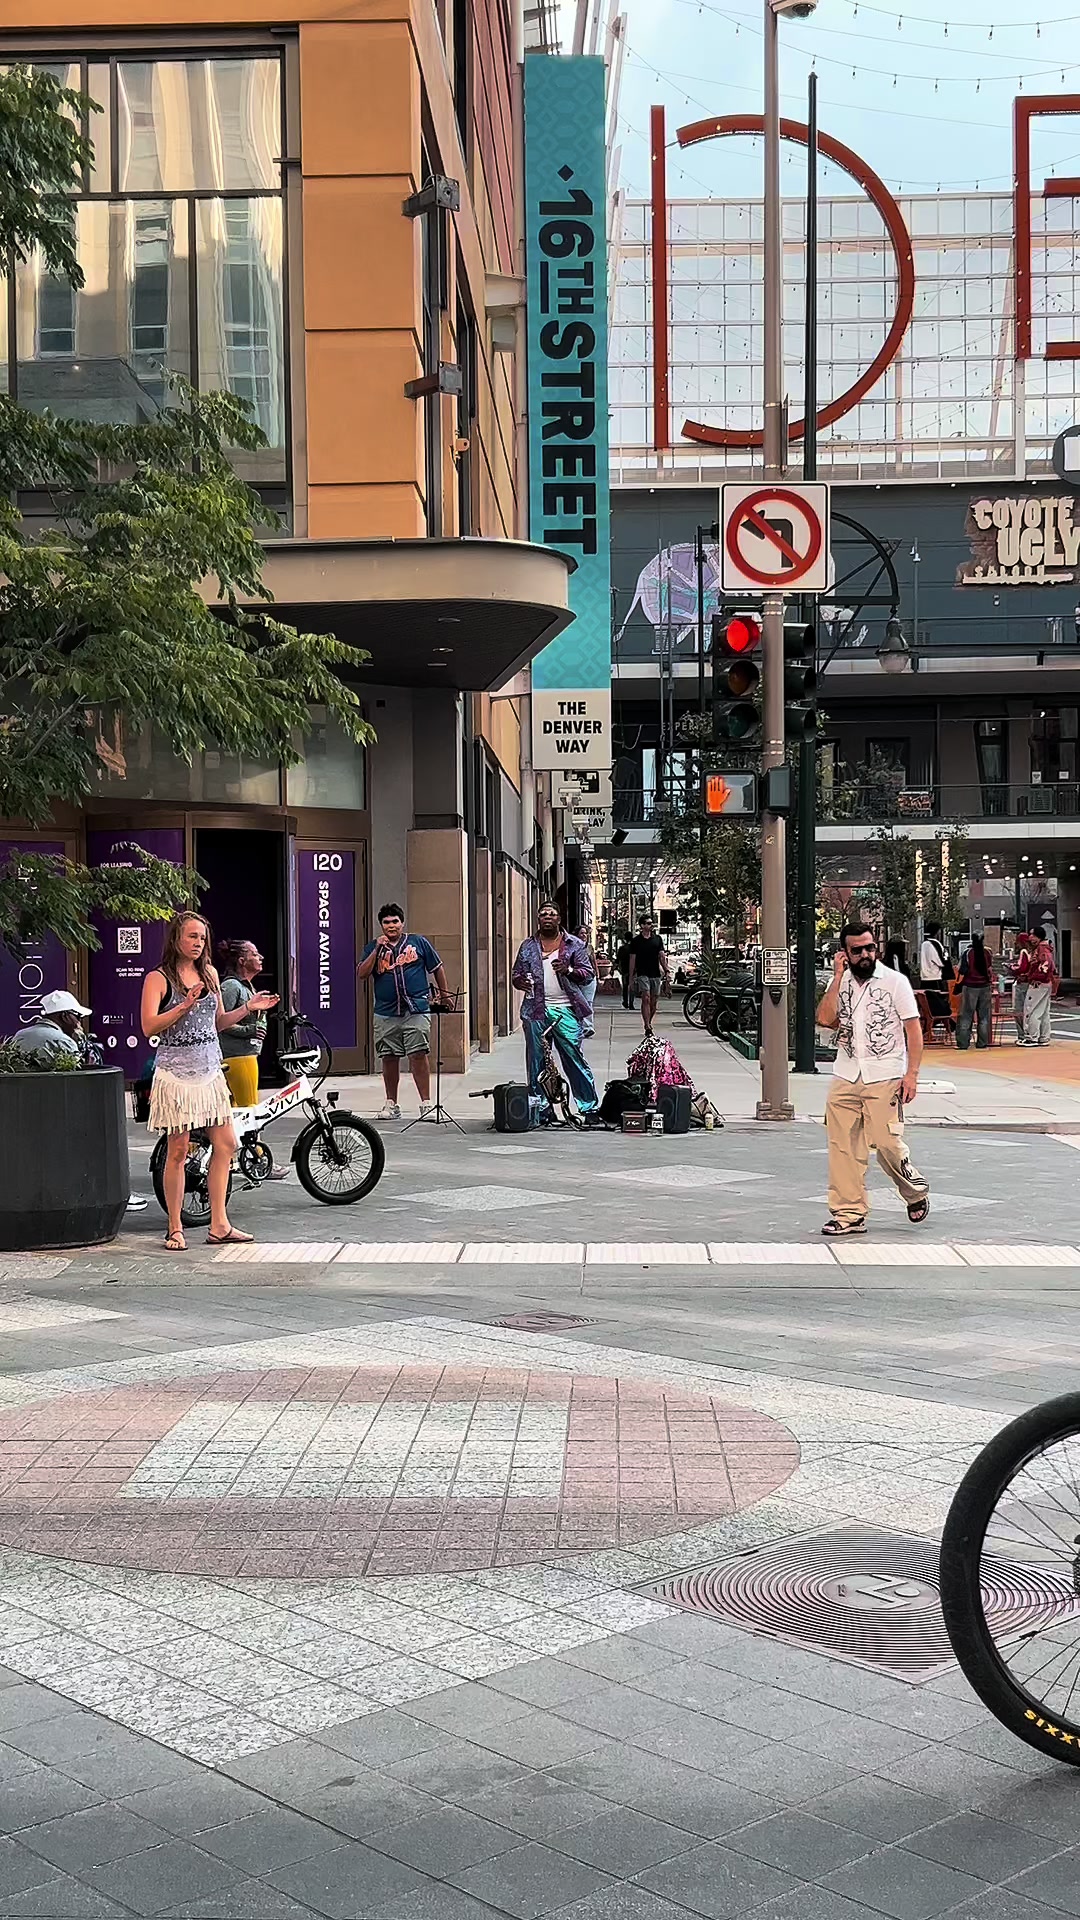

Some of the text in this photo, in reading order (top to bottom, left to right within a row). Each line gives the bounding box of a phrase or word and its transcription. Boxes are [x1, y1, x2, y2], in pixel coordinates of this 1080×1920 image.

[538, 189, 598, 555] 16TH STREET
[971, 497, 1075, 530] COYOTE
[997, 526, 1080, 567] UGLY
[557, 701, 587, 716] THE
[542, 720, 602, 735] DENVER
[555, 739, 590, 754] WAY
[587, 817, 605, 828] LAY
[313, 853, 343, 871] 120
[318, 880, 331, 1009] SPACE AVAILABLE
[268, 1090, 300, 1115] VIVI
